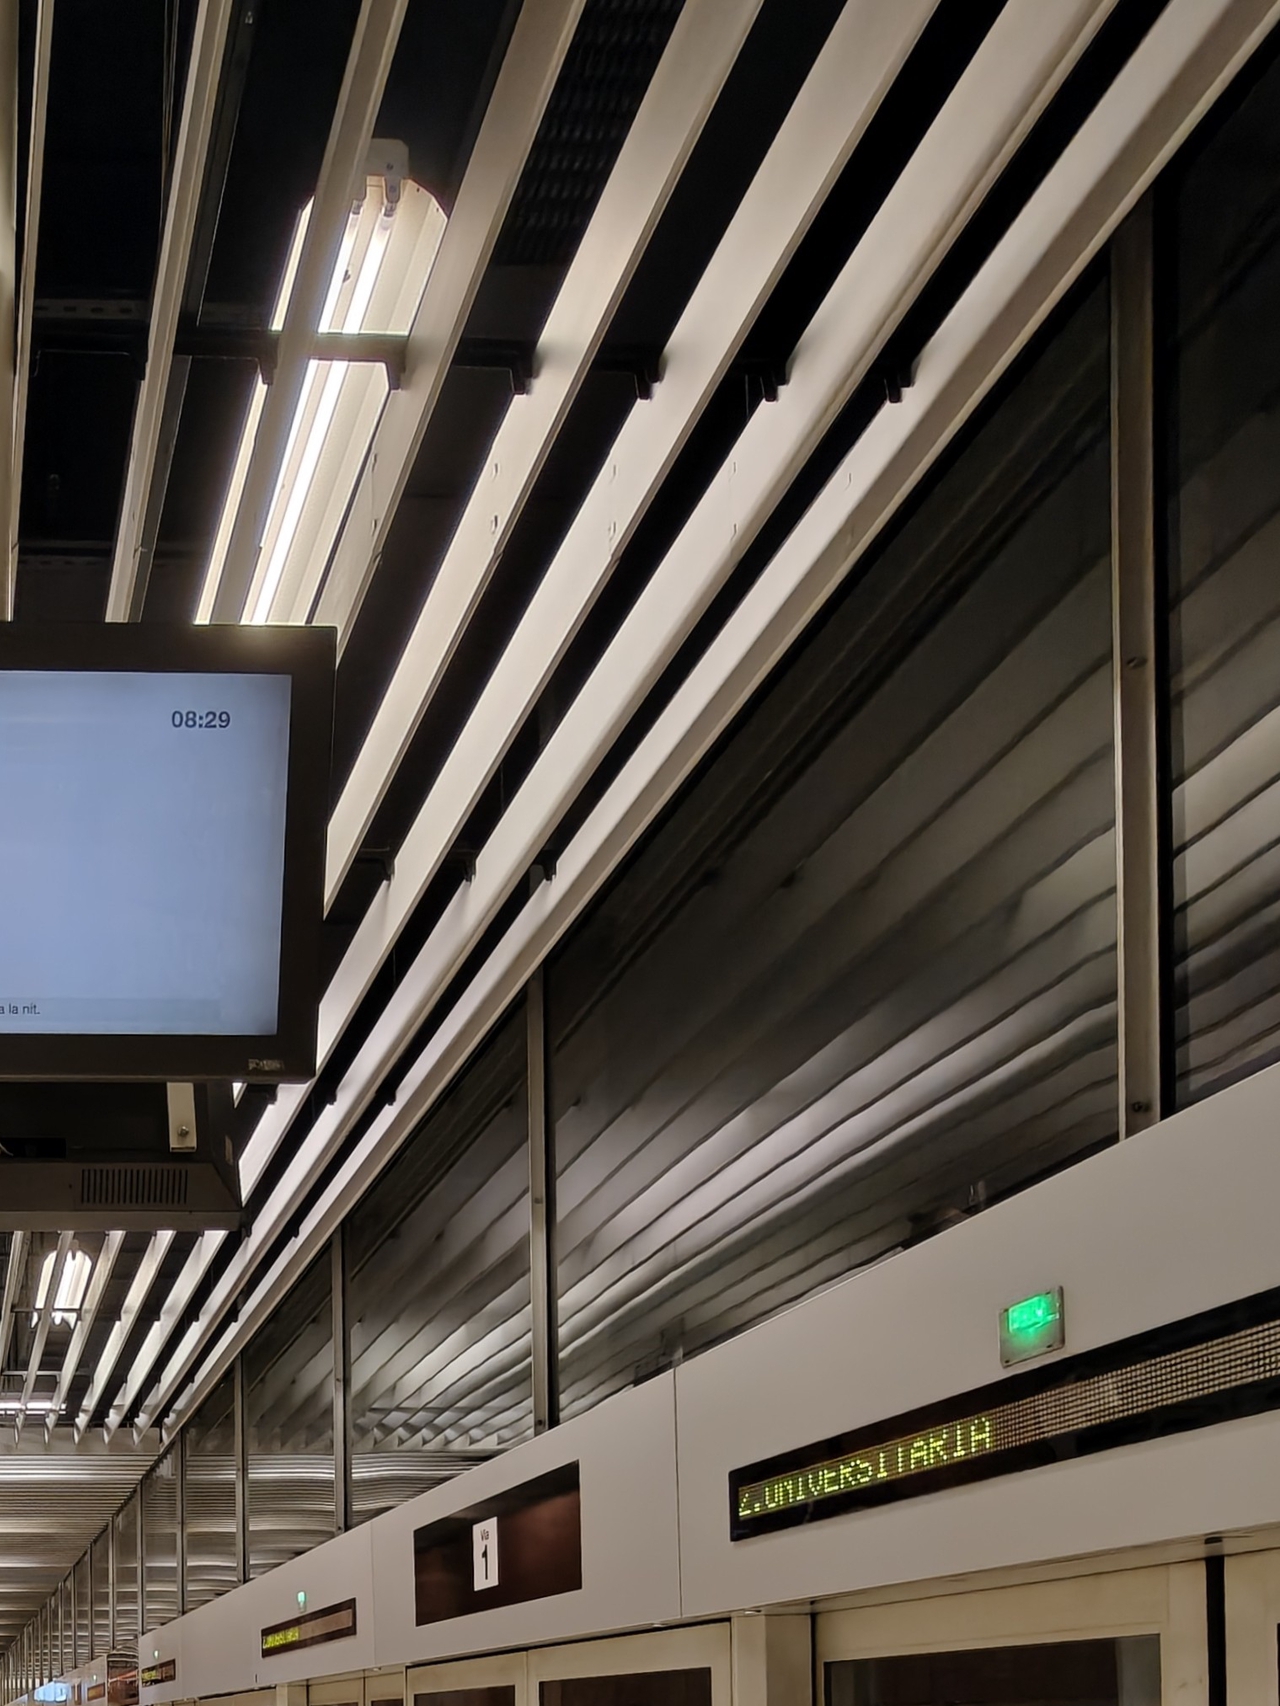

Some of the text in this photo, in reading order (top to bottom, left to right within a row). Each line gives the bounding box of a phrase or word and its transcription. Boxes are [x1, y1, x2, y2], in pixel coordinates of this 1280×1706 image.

[171, 710, 231, 729] 08:29
[8, 1003, 19, 1015] la
[481, 1543, 489, 1581] 1
